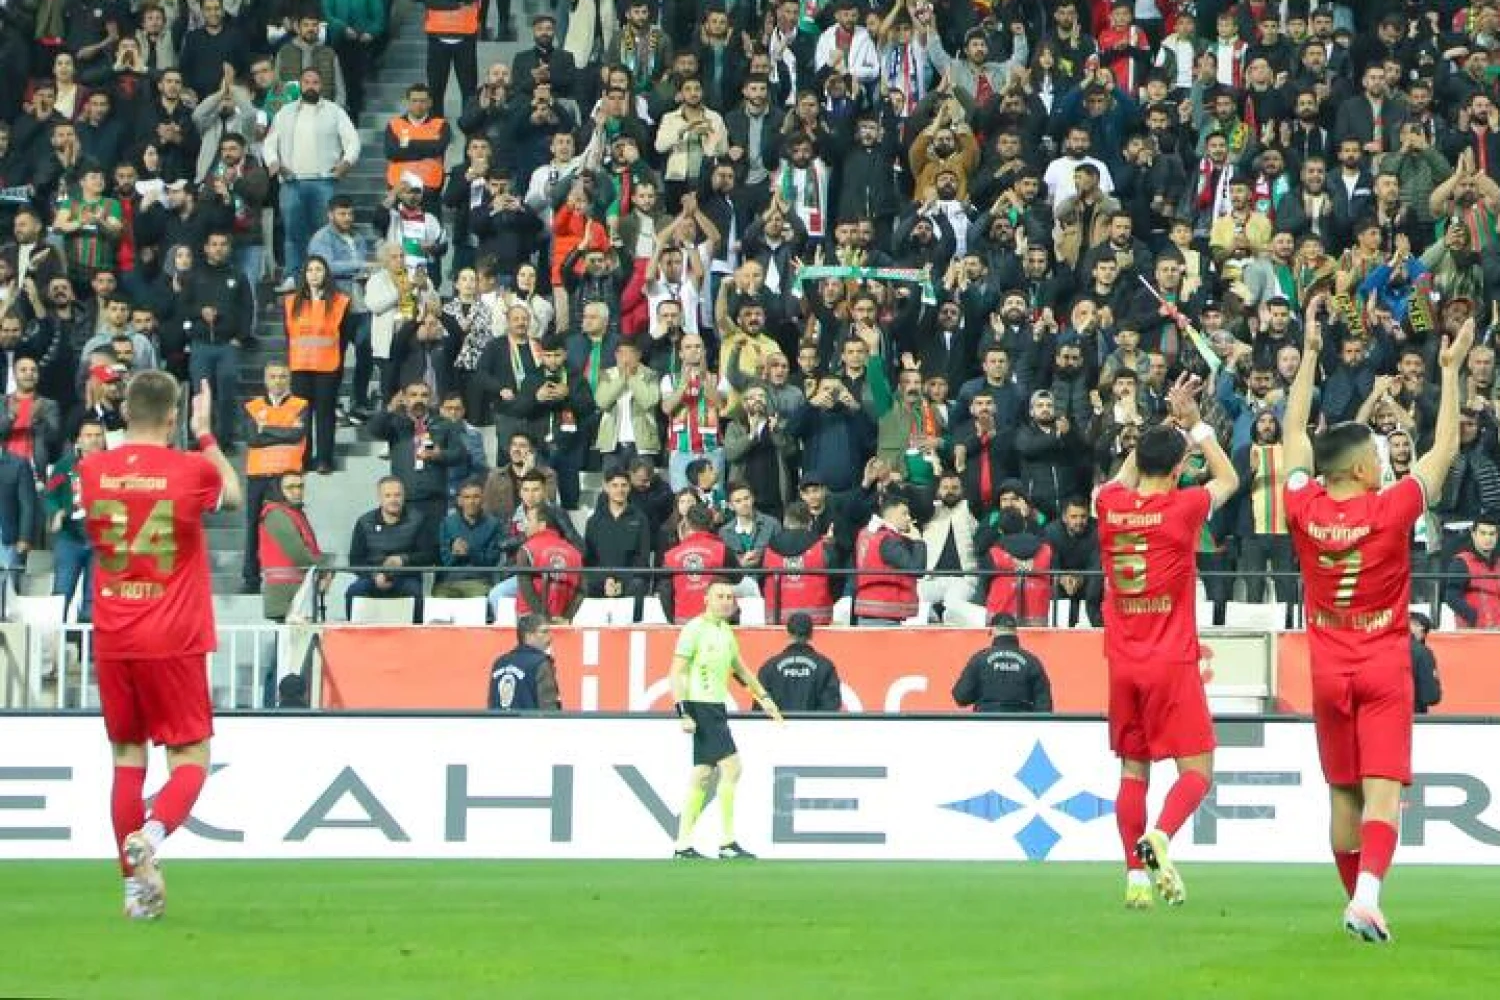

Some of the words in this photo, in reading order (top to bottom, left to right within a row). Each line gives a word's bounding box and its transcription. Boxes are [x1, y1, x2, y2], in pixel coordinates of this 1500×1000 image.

[91, 500, 175, 572] 34
[1318, 550, 1362, 606] 7
[0, 764, 888, 845] EAHVE
